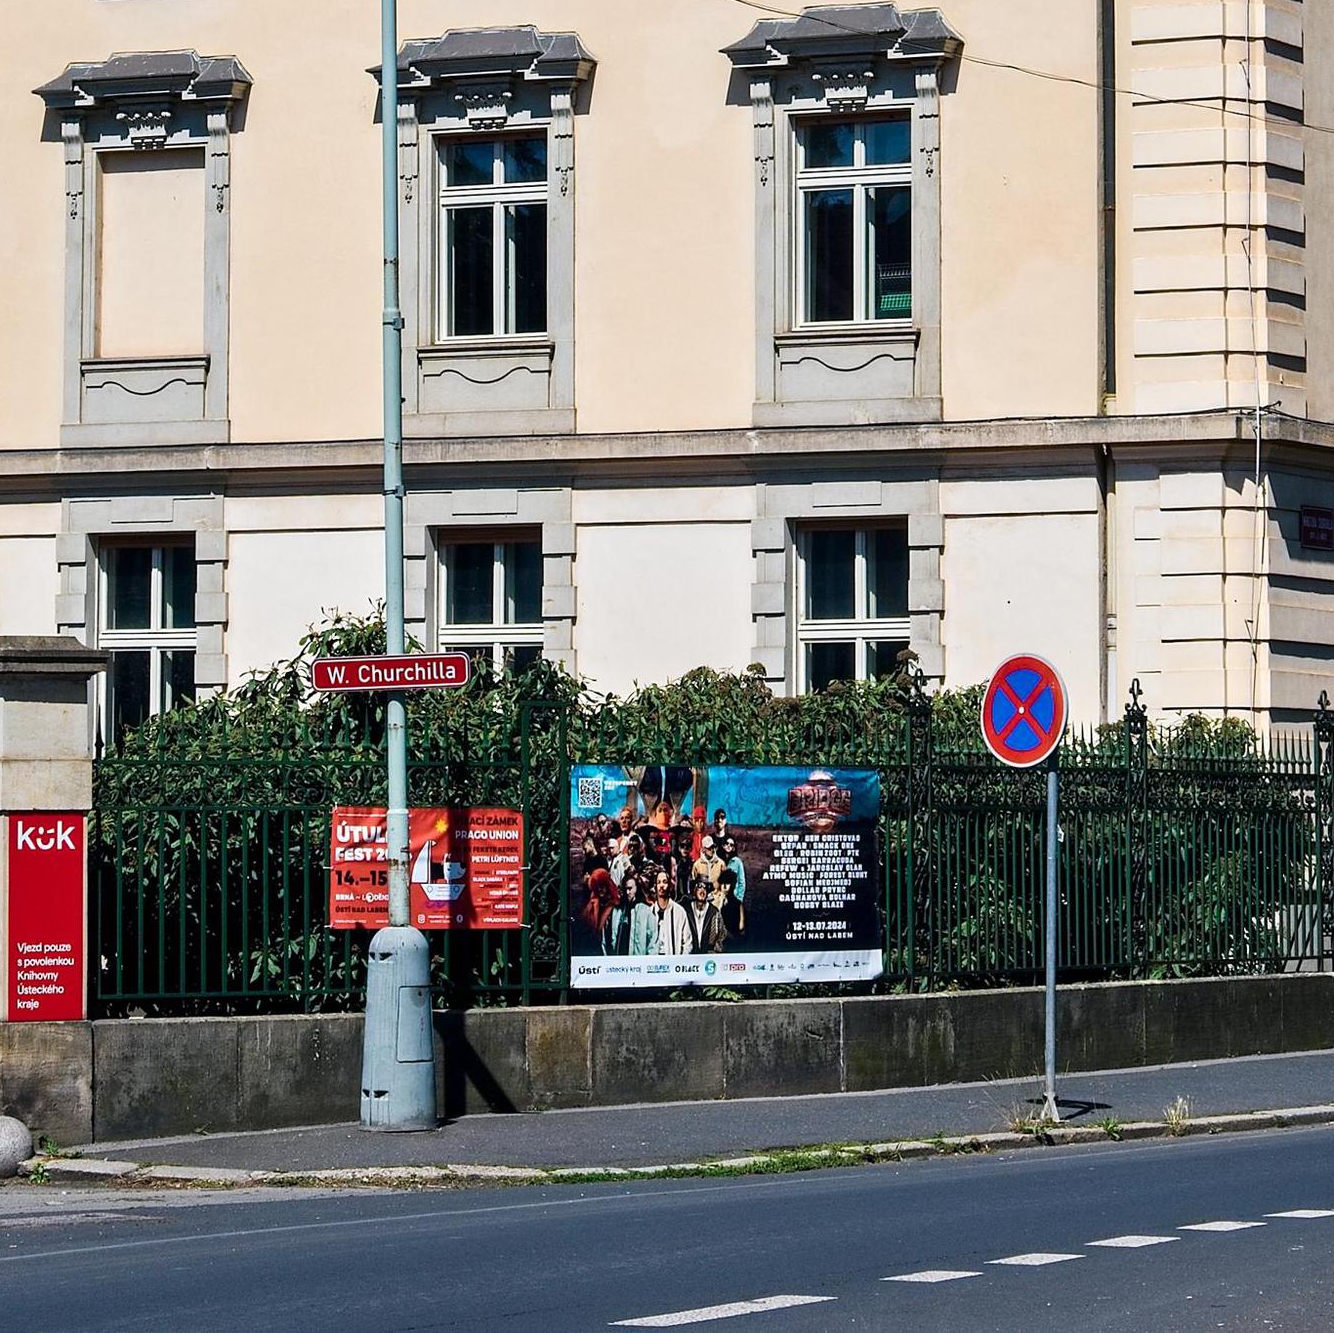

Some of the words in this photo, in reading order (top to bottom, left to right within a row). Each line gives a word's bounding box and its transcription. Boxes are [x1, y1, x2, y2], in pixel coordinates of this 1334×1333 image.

[327, 666, 349, 684] W.
[358, 662, 456, 683] Churchilla
[487, 815, 518, 826] ZÁMEK
[337, 820, 388, 843] ÚTUL
[455, 830, 488, 840] PRAGO
[489, 830, 519, 840] UNION
[335, 847, 373, 861] FEST
[763, 871, 787, 879] ATMO
[789, 871, 814, 879] MUSIC
[791, 886, 820, 894] DOLLAR
[792, 921, 846, 931] 12-13.07.2024
[808, 931, 825, 940] NAD
[827, 931, 853, 939] LABEM
[17, 942, 42, 954] Vjezd
[44, 943, 72, 954] pouze
[17, 958, 23, 967] s
[24, 956, 75, 968] povolenkou
[17, 970, 58, 982] Knihovny
[17, 982, 64, 995] Ústeckého
[17, 998, 39, 1010] kraje
